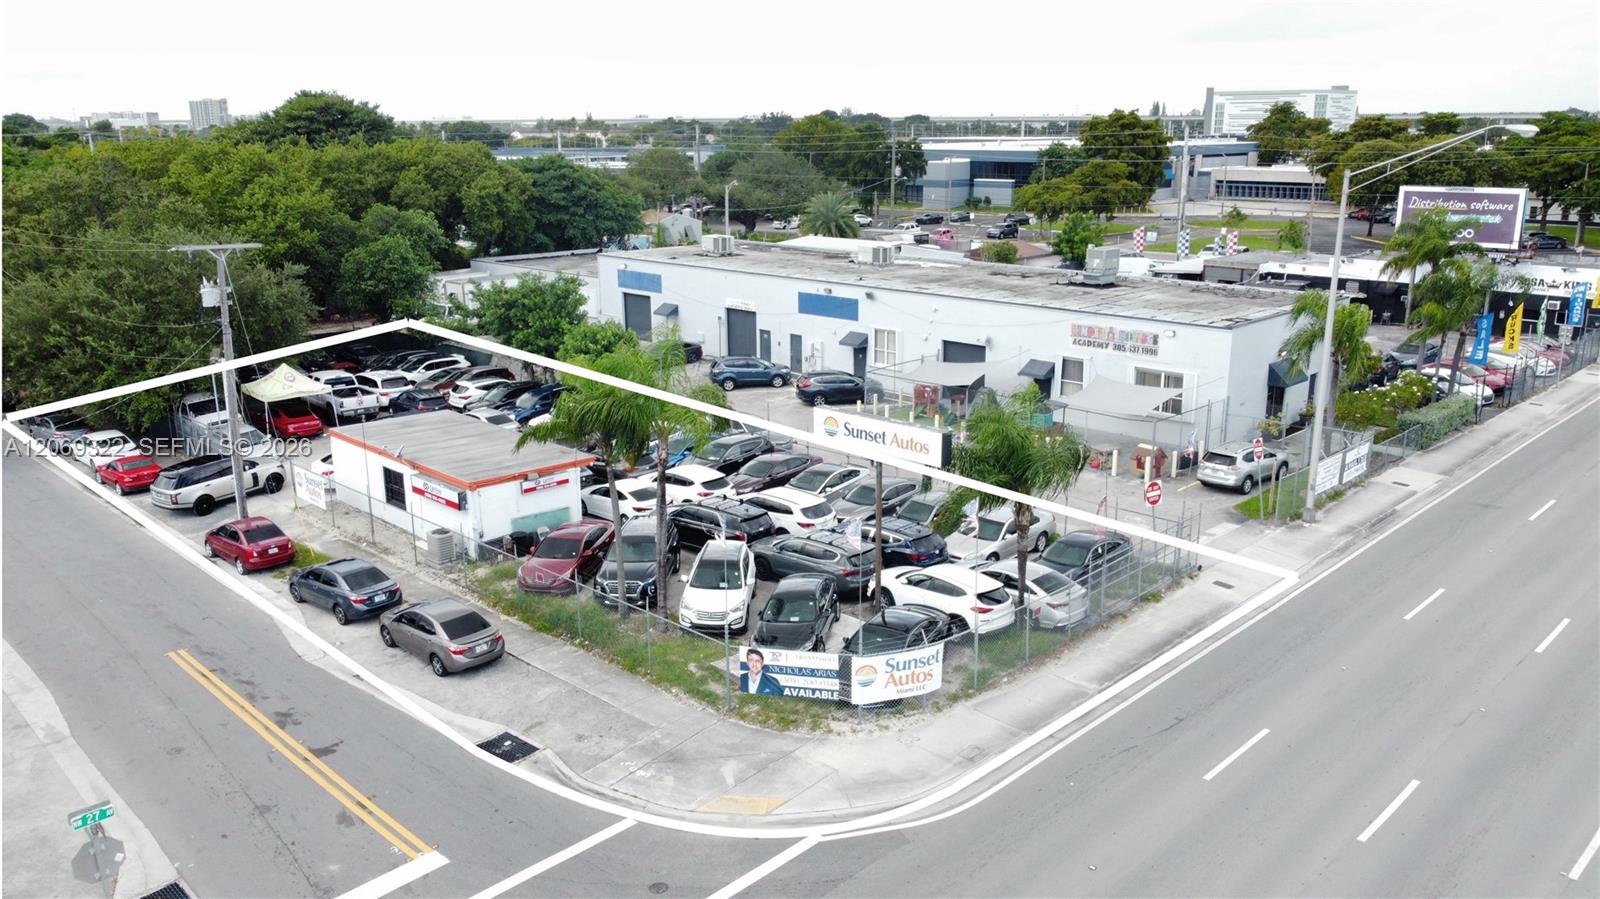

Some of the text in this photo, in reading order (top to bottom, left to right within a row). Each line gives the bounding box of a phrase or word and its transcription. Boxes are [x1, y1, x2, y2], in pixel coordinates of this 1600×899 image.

[1408, 196, 1514, 212] Distribution software
[1072, 339, 1110, 349] ACADEMY
[1474, 319, 1488, 360] SALE
[844, 422, 930, 455] Sunset Autos
[885, 649, 939, 673] Sunset
[768, 665, 837, 678] NICHOLAS ARIAS
[884, 669, 934, 689] Autos
[783, 687, 839, 700] AVAILABLE
[896, 683, 927, 695] Miami LLC
[86, 810, 100, 825] 27
